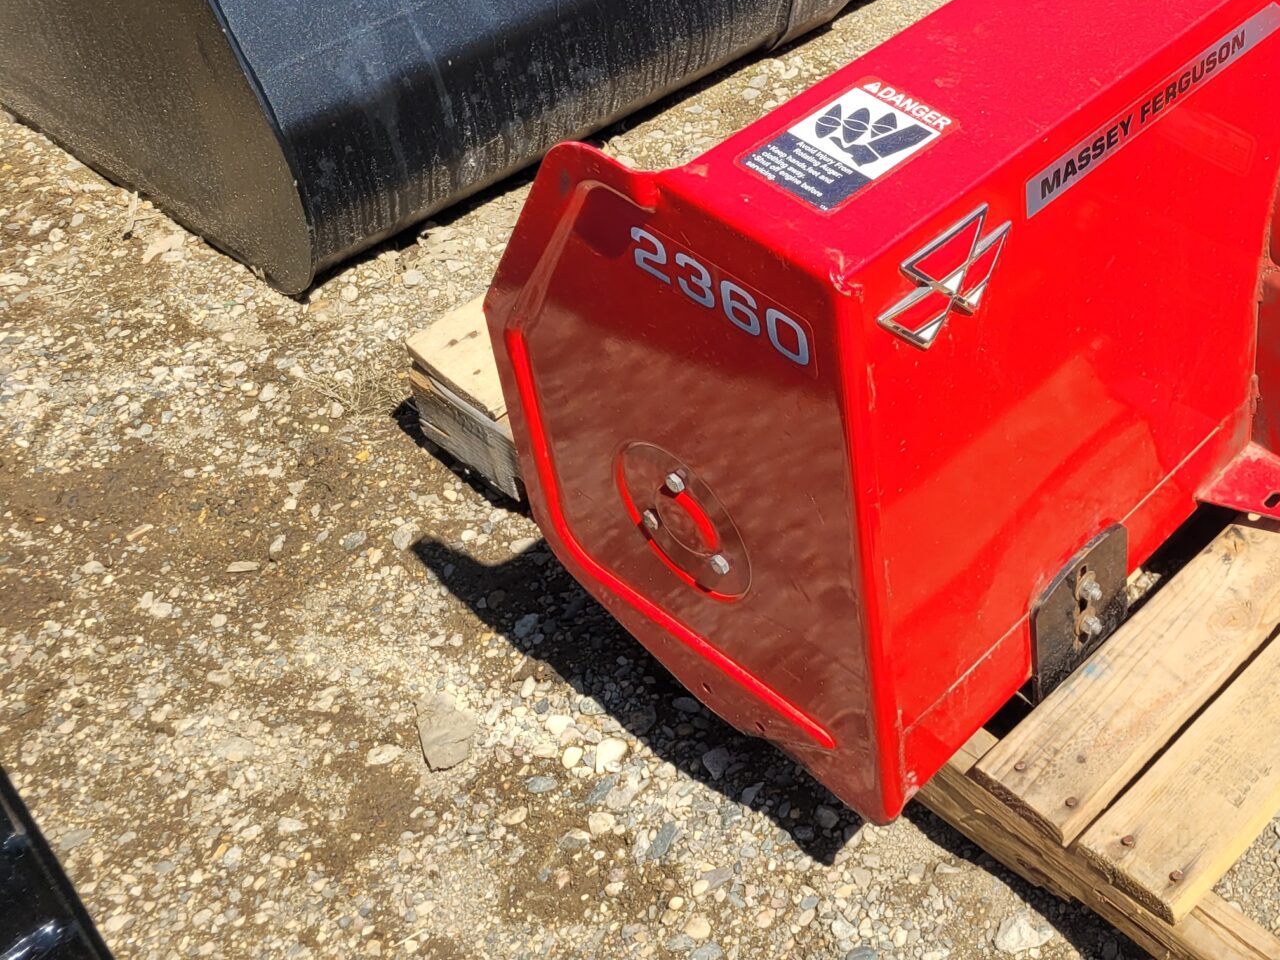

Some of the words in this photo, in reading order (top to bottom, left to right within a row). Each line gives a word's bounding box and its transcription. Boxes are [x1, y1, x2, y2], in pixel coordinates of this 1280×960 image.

[877, 86, 953, 131] DANGER
[1040, 114, 1134, 199] MASSEY
[1140, 30, 1246, 124] FERGUSON
[754, 155, 771, 166] Shut
[779, 171, 801, 184] engine
[801, 182, 822, 197] before
[762, 152, 788, 168] clothing
[770, 146, 787, 158] Keep
[819, 175, 834, 184] and
[793, 148, 820, 166] Rotating
[797, 142, 818, 154] Avoid
[816, 152, 835, 165] Injury
[834, 162, 853, 174] From
[630, 226, 810, 366] 2360
